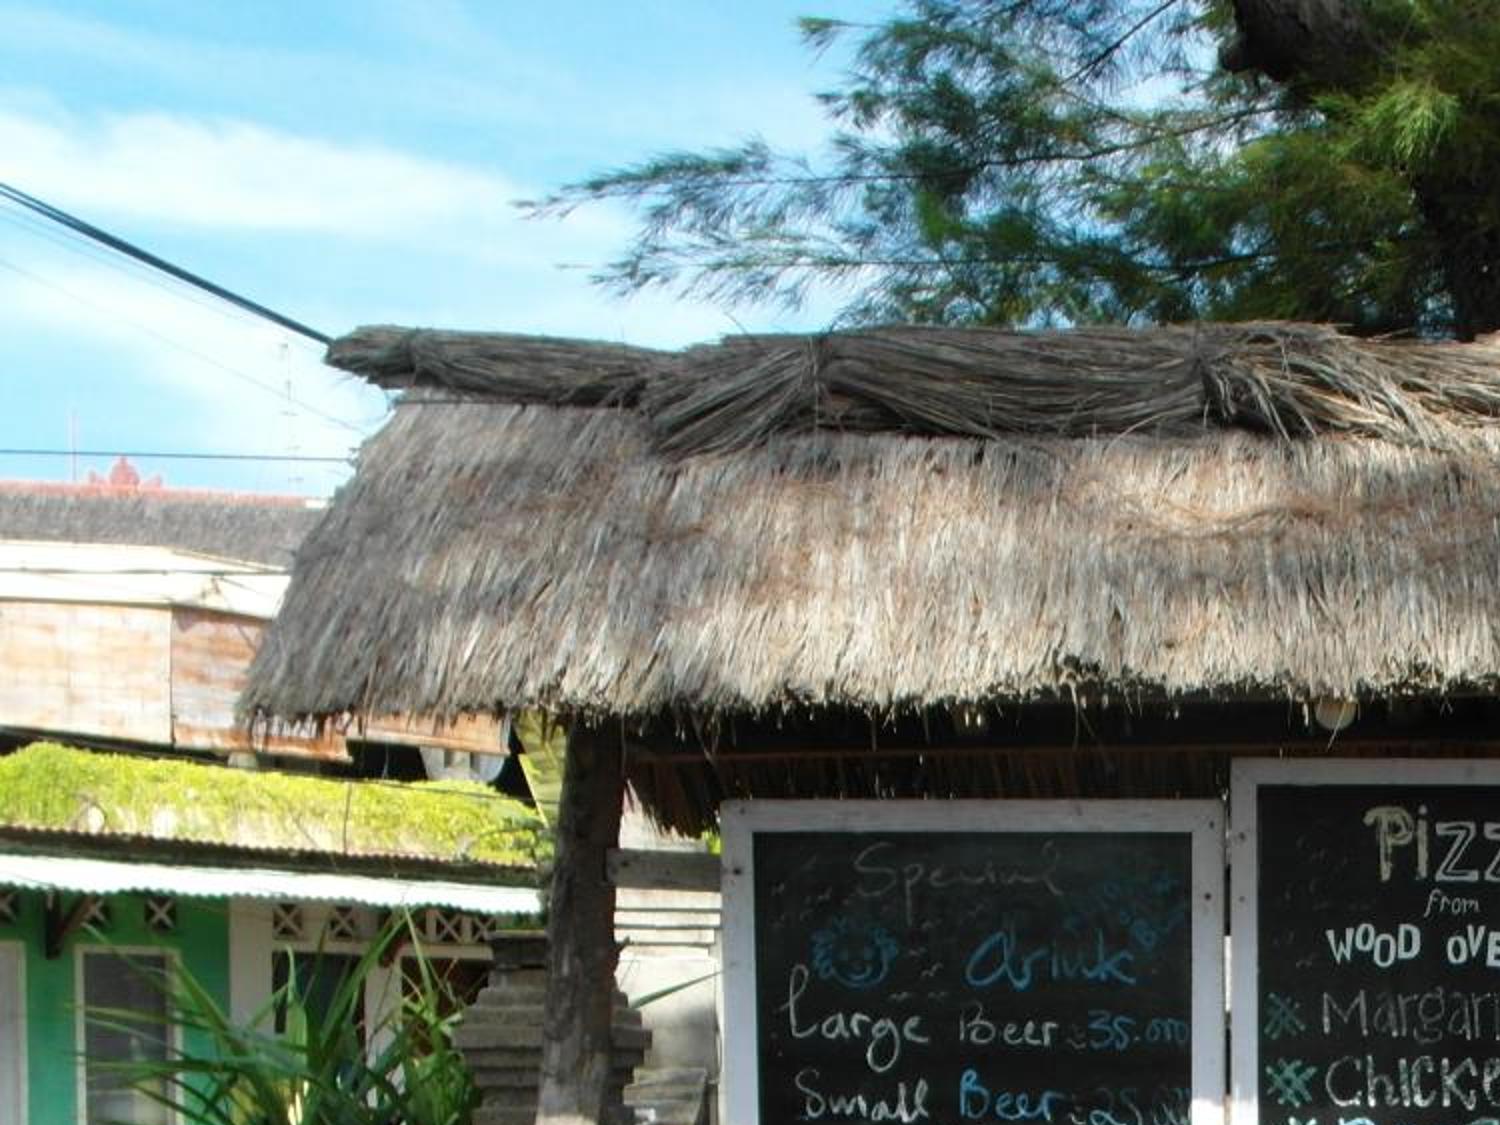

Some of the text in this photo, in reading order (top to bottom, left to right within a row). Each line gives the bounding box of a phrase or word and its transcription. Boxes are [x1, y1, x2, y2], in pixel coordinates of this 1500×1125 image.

[1424, 888, 1481, 917] from
[1326, 923, 1421, 967] WOOD
[960, 1003, 1059, 1046] Beer
[795, 1070, 928, 1121] Small
[960, 1069, 1063, 1121] Beer
